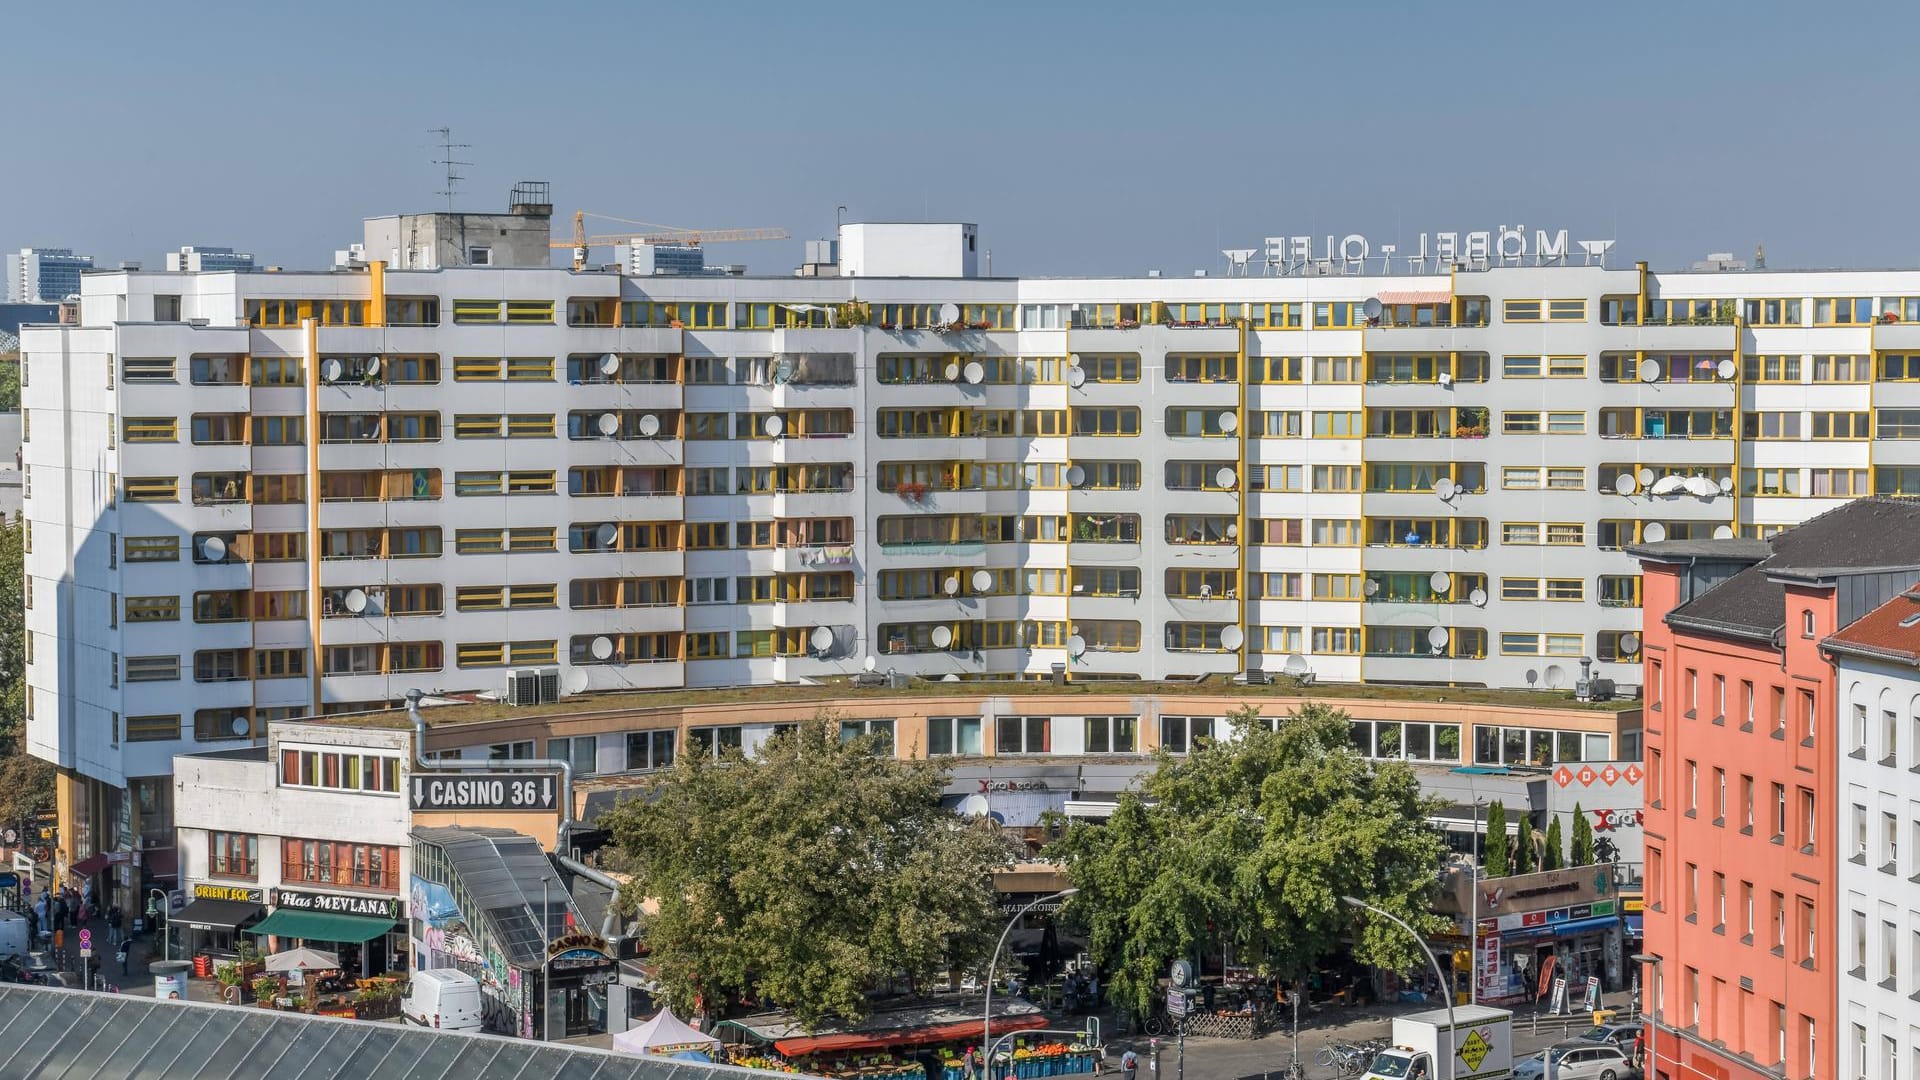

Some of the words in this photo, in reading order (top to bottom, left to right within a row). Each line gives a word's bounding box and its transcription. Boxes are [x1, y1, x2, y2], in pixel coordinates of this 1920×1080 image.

[430, 780, 504, 805] CASINO
[511, 780, 537, 805] 36
[195, 886, 228, 900] ORIENT
[230, 888, 249, 901] ECK
[314, 895, 389, 915] MEVLANA
[548, 935, 591, 954] CASINO
